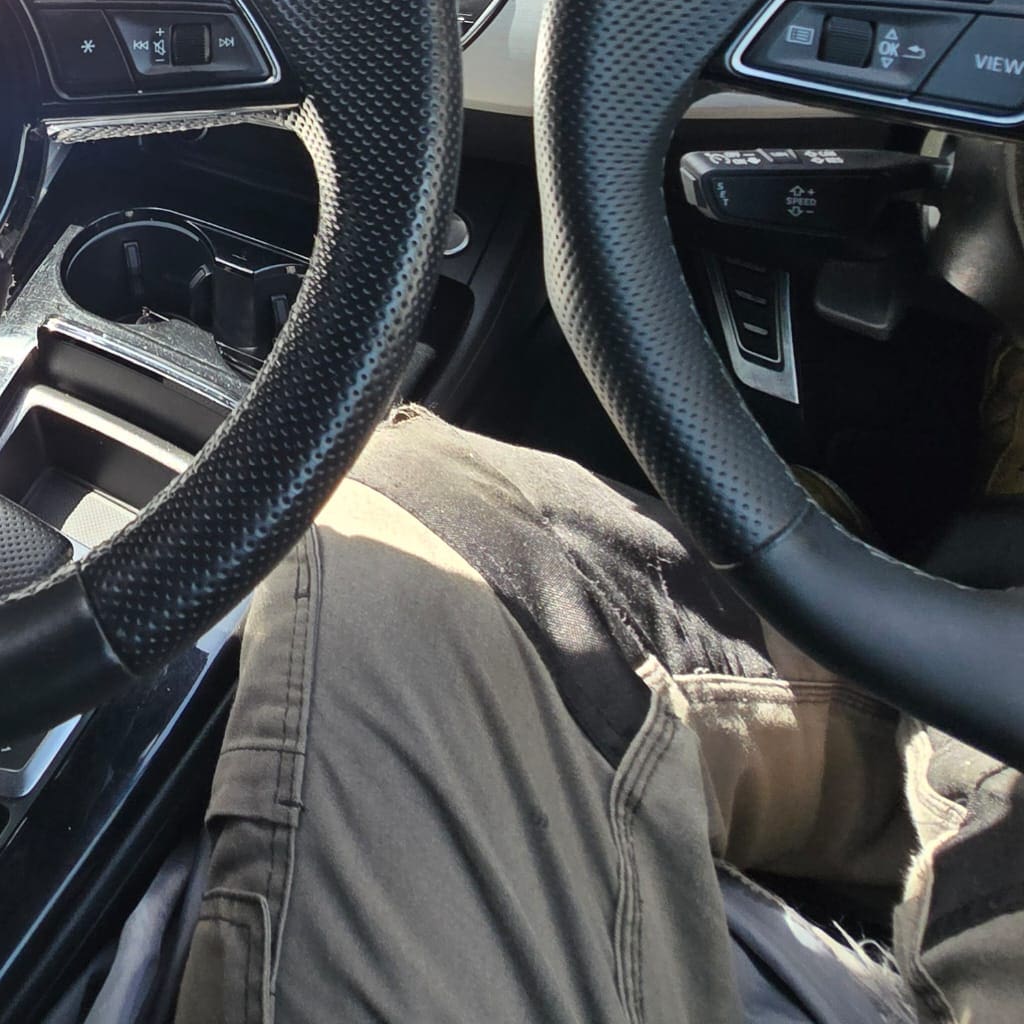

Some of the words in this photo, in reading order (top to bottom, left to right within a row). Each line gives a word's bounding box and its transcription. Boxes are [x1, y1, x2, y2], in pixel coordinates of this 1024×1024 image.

[878, 40, 899, 58] OK
[974, 53, 1024, 75] VIEW
[786, 196, 817, 206] SPEED
